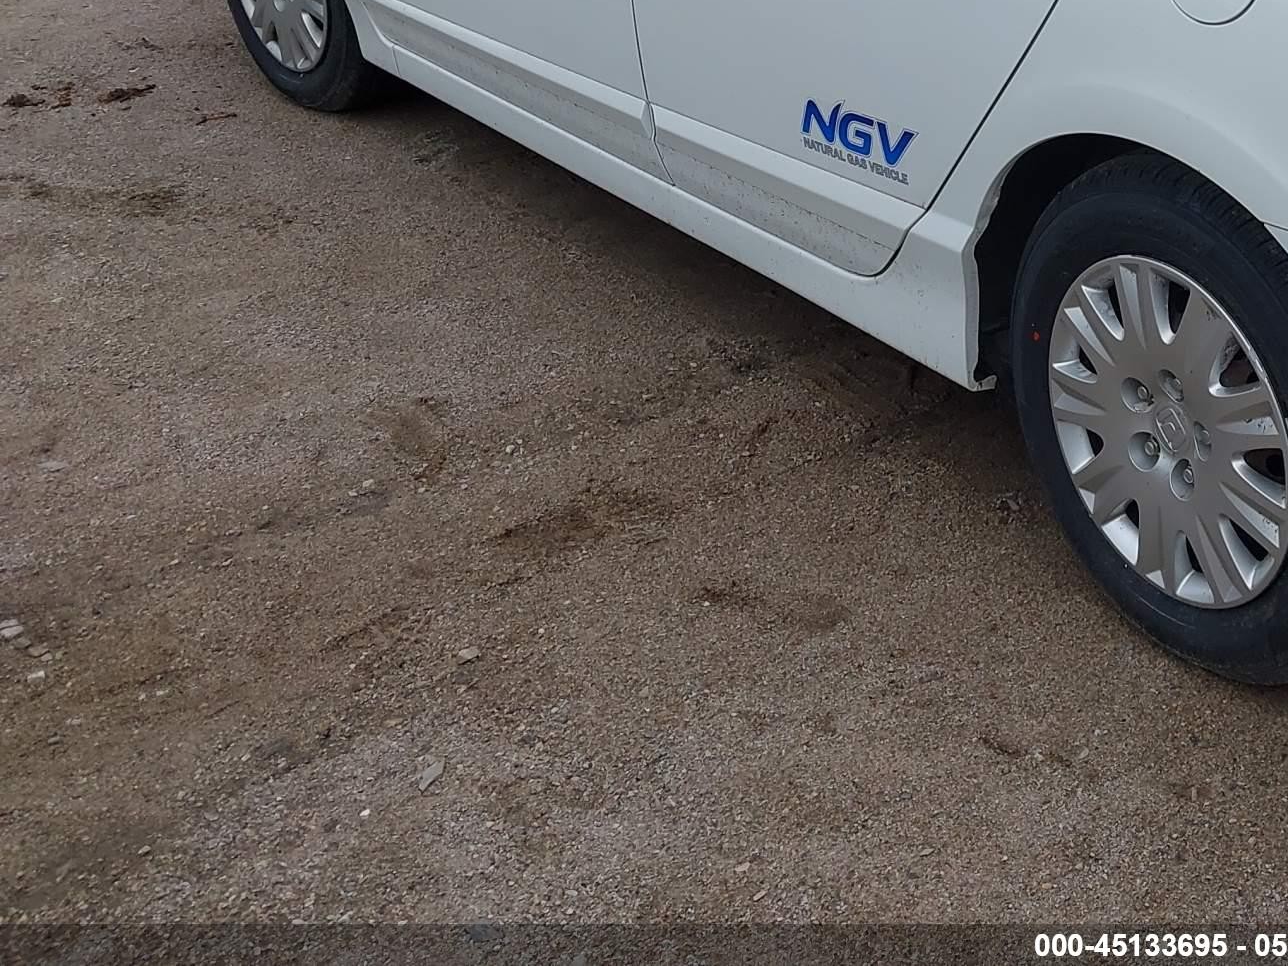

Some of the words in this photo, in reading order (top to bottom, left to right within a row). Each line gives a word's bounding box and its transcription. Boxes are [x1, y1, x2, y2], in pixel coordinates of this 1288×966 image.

[801, 98, 919, 167] NGV
[803, 138, 846, 162] NATURAL
[846, 153, 868, 170] GAS
[869, 160, 910, 185] VEHICLE
